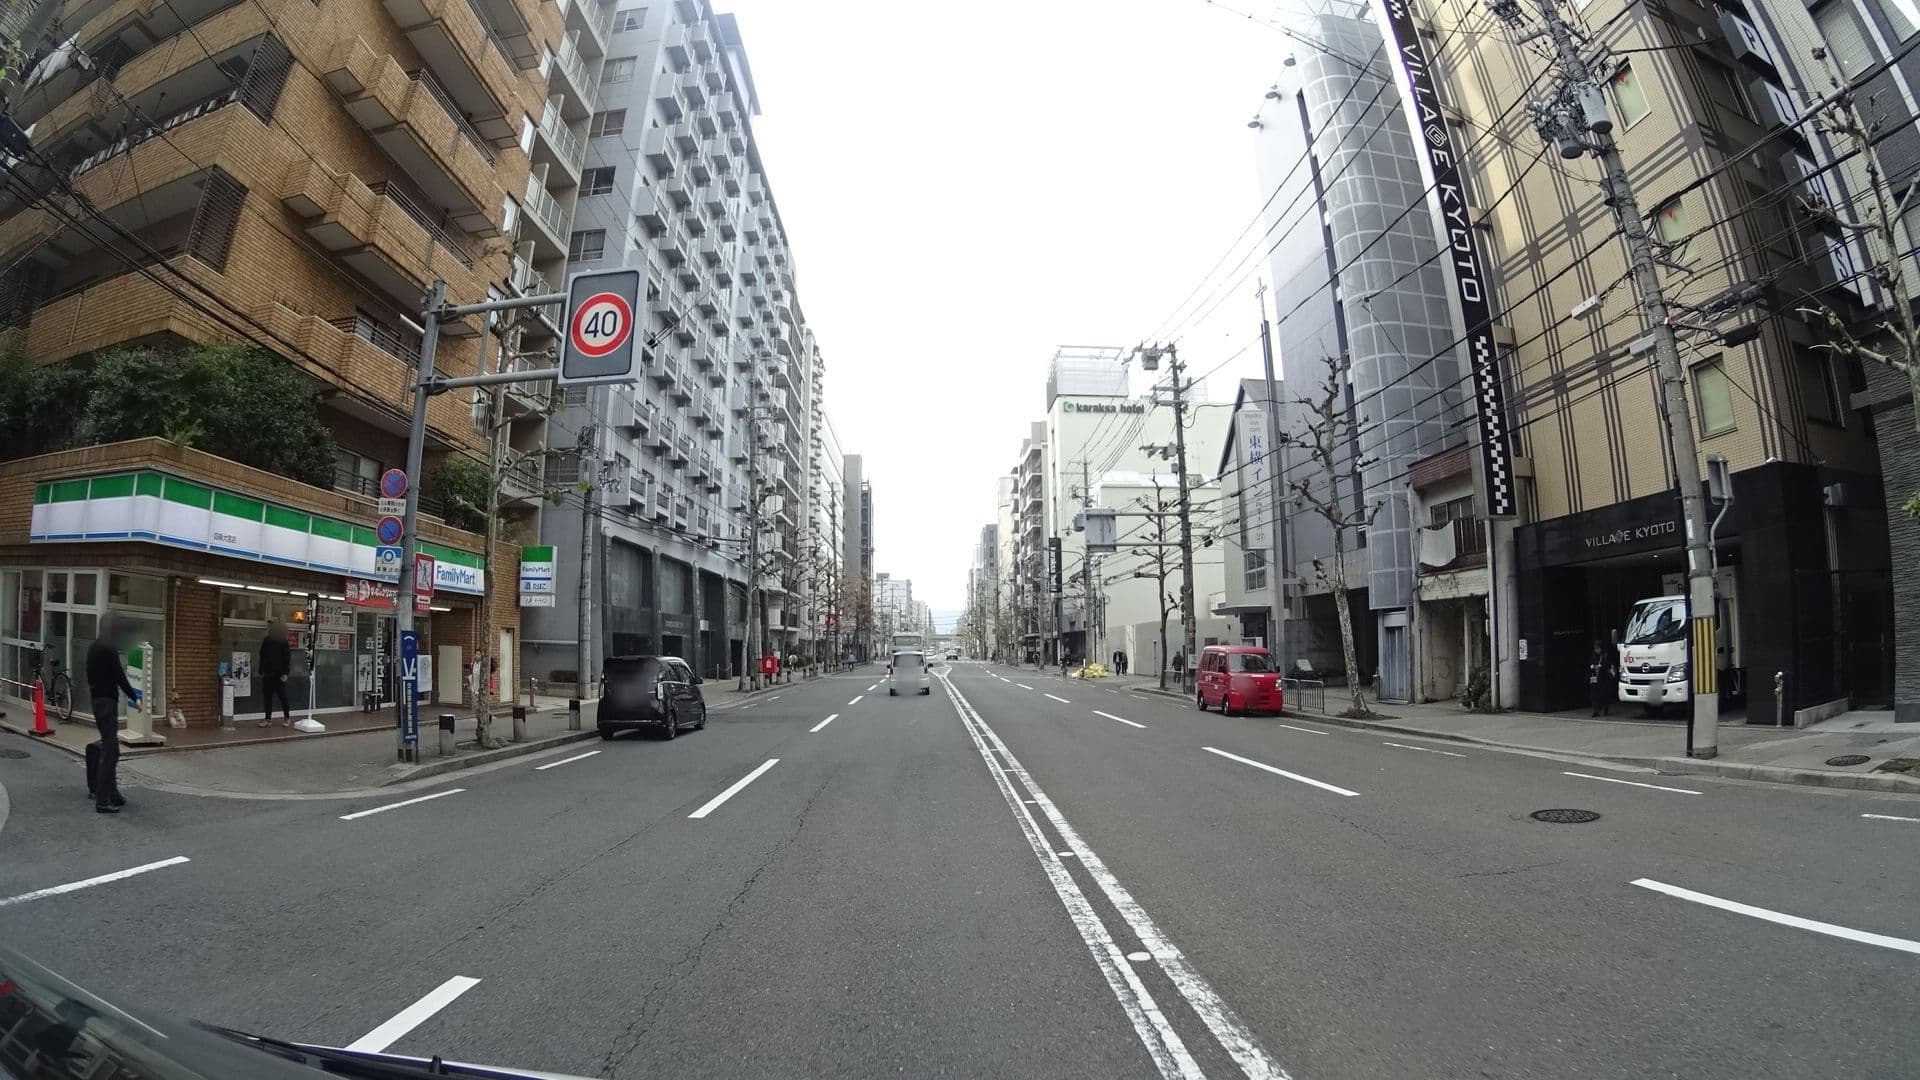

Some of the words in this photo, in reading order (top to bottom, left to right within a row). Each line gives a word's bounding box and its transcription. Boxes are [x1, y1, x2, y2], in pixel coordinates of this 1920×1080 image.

[1403, 44, 1451, 169] VILLAGE
[1441, 183, 1481, 302] KYOTO
[584, 310, 617, 338] 40
[1076, 402, 1116, 414] karaksa
[1120, 403, 1145, 414] hotel
[1635, 521, 1675, 538] KYOTO
[437, 565, 476, 585] FamilyMart
